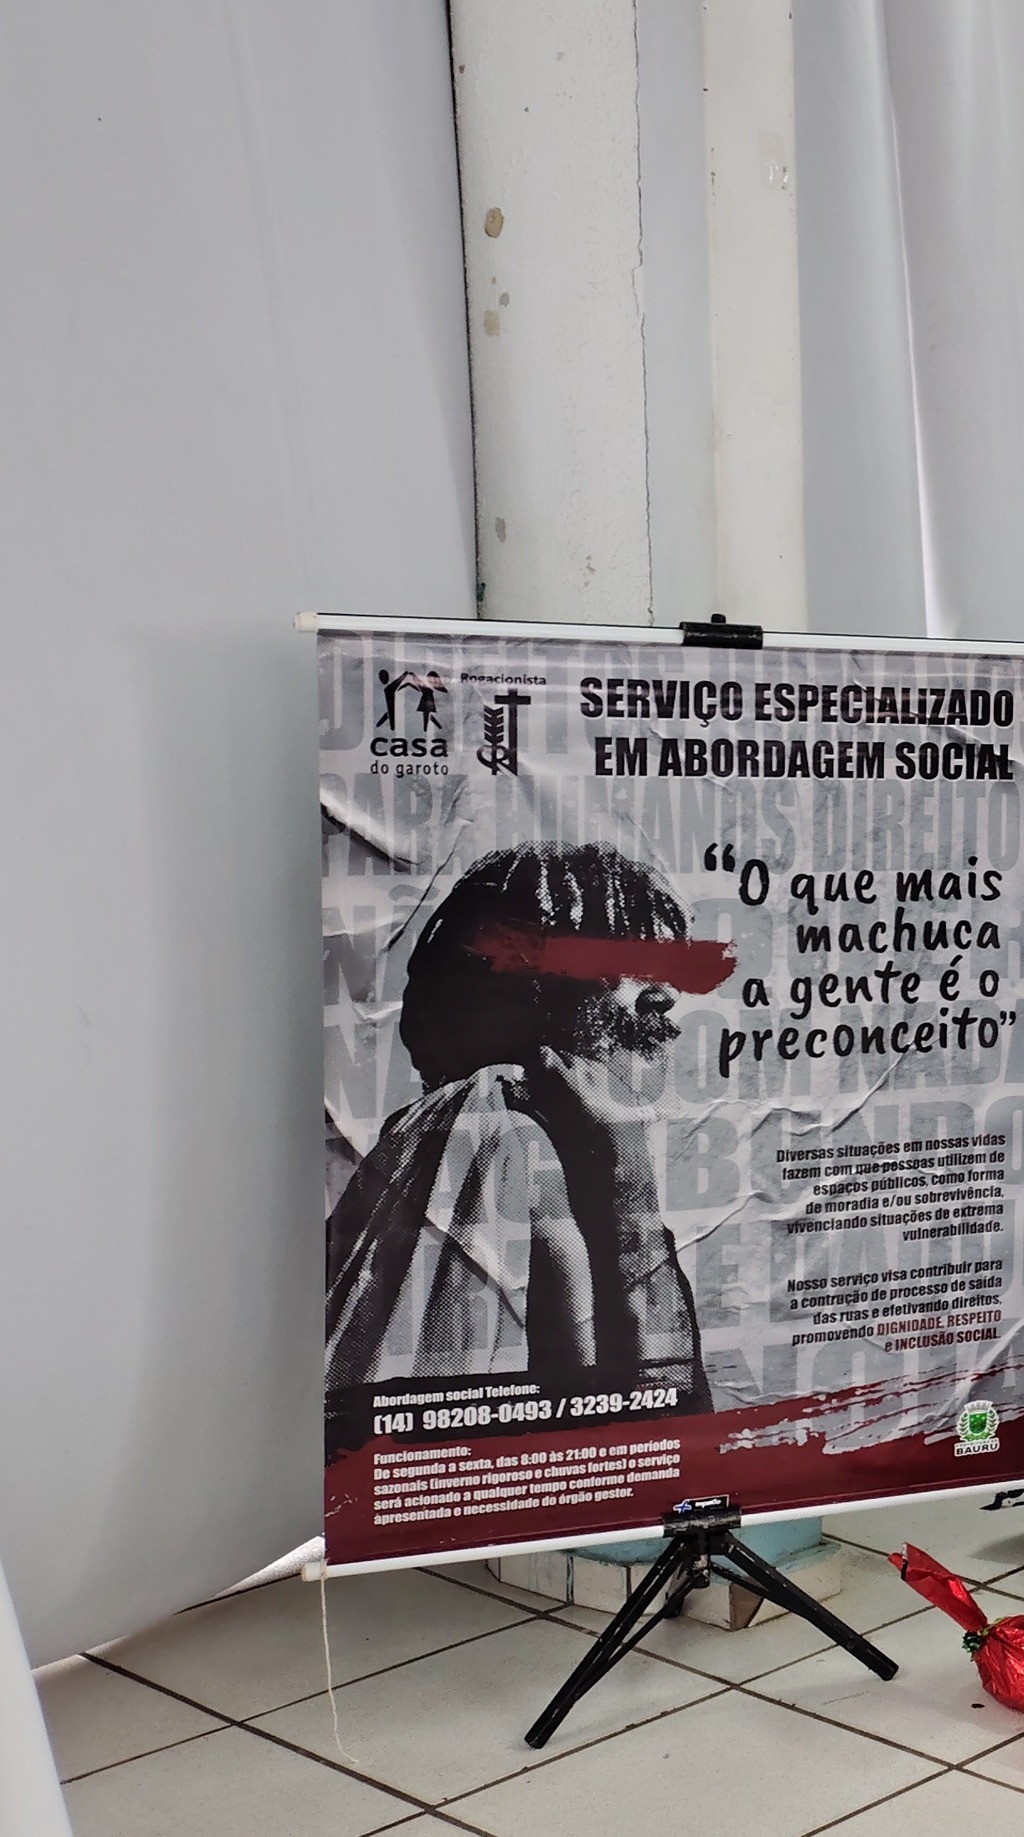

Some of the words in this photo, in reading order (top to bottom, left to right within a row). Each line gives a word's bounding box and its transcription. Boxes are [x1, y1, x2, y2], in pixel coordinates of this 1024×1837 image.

[460, 672, 546, 685] Rogacionista
[580, 676, 743, 727] SERVIÇO
[754, 682, 1014, 727] ESPECIALIZADO
[370, 736, 448, 757] casa
[594, 736, 648, 776] EM
[657, 737, 885, 779] ABORDAGEM
[895, 741, 1015, 780] SOCIAL
[370, 759, 389, 774] do
[395, 761, 448, 779] garoto
[790, 869, 877, 915] que
[896, 855, 1002, 902] mais
[796, 905, 1000, 954] machuca
[741, 977, 769, 1008] a
[789, 960, 921, 1020] gente
[939, 954, 963, 1001] é
[979, 969, 999, 997] o
[776, 1148, 834, 1162] Diversas
[836, 1141, 900, 1158] situações
[903, 1140, 922, 1152] em
[925, 1136, 969, 1151] nossas
[971, 1133, 1005, 1146] vidas
[782, 1166, 821, 1180] fazem
[824, 1164, 852, 1177] com
[854, 1162, 880, 1175] que
[881, 1157, 935, 1173] pessoas
[937, 1152, 986, 1167] utilizem
[989, 1150, 1004, 1163] de
[813, 1181, 868, 1196] espaços
[931, 1172, 965, 1185] como
[967, 1169, 1004, 1182] forma
[805, 1201, 822, 1214] de
[824, 1196, 879, 1212] moradia
[882, 1194, 911, 1208] e/ou
[914, 1185, 1004, 1204] sobrevivência,
[786, 1215, 867, 1234] vivenciando
[869, 1209, 932, 1227] situações
[935, 1207, 949, 1220] de
[952, 1203, 1003, 1218] extrema
[902, 1220, 1003, 1241] vulnerabilidade.
[787, 1278, 827, 1292] Nosso
[830, 1272, 878, 1287] serviço
[881, 1269, 907, 1282] visa
[910, 1261, 972, 1279] contribuir
[974, 1259, 1002, 1273] para
[790, 1298, 798, 1309] a
[800, 1289, 868, 1308] contrução
[871, 1288, 886, 1301] de
[889, 1282, 948, 1300] processo
[950, 1279, 965, 1292] de
[968, 1275, 1002, 1290] saída
[812, 1311, 837, 1325] das
[839, 1309, 869, 1322] ruas
[871, 1307, 879, 1318] e
[882, 1299, 949, 1317] efetivando
[791, 1325, 874, 1347] promovendo
[946, 1309, 1001, 1328] RESPEITO
[884, 1341, 892, 1352] e
[895, 1330, 954, 1351] INCLUSÃO
[372, 1392, 444, 1408] Abordagem
[445, 1387, 483, 1401] social
[484, 1384, 540, 1398] Telefone:
[423, 1401, 552, 1430] 98208-0493
[556, 1397, 566, 1418] /
[570, 1387, 678, 1416] 3239-2424
[373, 1446, 471, 1465] Funcionamento:
[373, 1468, 390, 1480] De
[392, 1462, 446, 1478] segunda
[448, 1462, 456, 1472] a
[458, 1458, 494, 1471] sexta,
[496, 1455, 518, 1467] das
[520, 1451, 547, 1465] 8:00
[548, 1450, 564, 1462] às
[565, 1446, 596, 1461] 21:00
[598, 1447, 607, 1457] e
[608, 1445, 627, 1456] em
[956, 1443, 998, 1455] BAURU
[373, 1479, 428, 1495] sazonais
[481, 1469, 533, 1484] rigoroso
[534, 1468, 542, 1479] e
[543, 1464, 586, 1477] chuvas
[628, 1458, 636, 1468] o
[637, 1453, 680, 1467] serviço
[373, 1496, 402, 1510] será
[404, 1491, 461, 1507] acionado
[463, 1491, 471, 1501] a
[473, 1485, 528, 1500] qualquer
[529, 1480, 567, 1494] tempo
[568, 1474, 624, 1489] conforme
[626, 1467, 680, 1483] demanda
[453, 1506, 461, 1516] e
[463, 1497, 539, 1515] necessidade
[541, 1495, 556, 1506] do
[558, 1490, 592, 1504] órgão
[594, 1487, 633, 1501] gestor.
